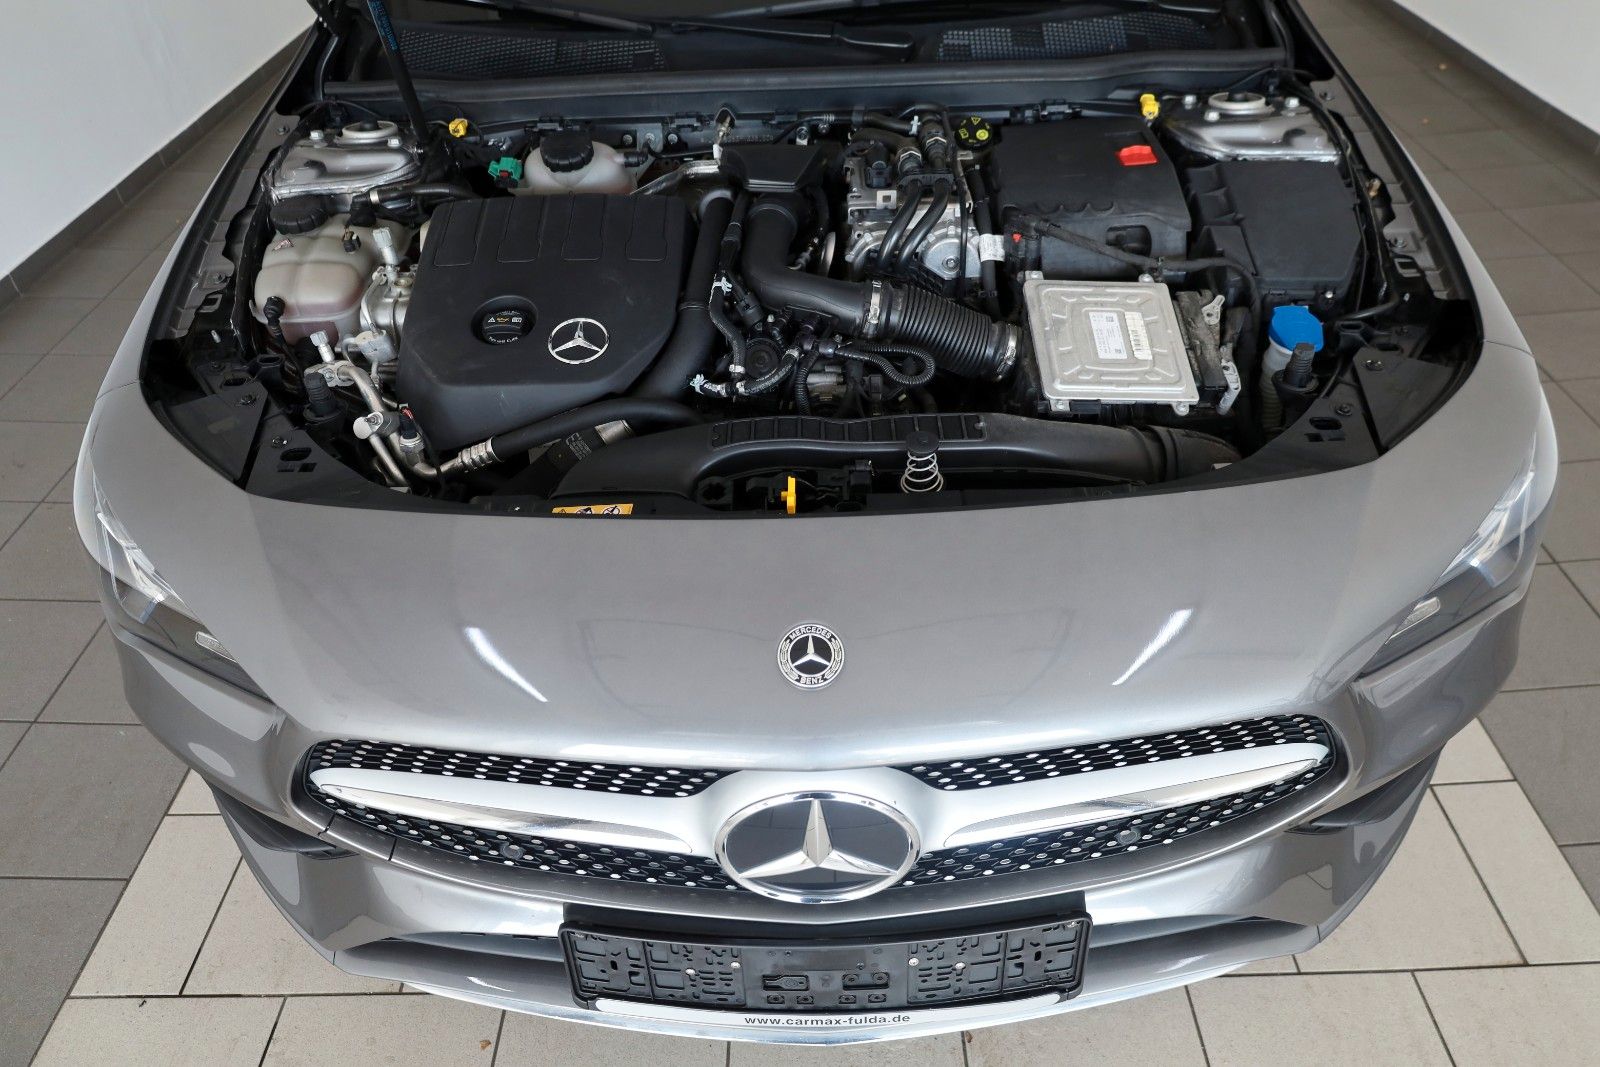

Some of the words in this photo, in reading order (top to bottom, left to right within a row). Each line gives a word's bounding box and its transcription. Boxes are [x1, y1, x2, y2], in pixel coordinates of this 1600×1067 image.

[789, 626, 831, 640] MERCEDES
[800, 676, 824, 685] BENZ
[744, 1014, 911, 1026] www.carmax-fulda.de
